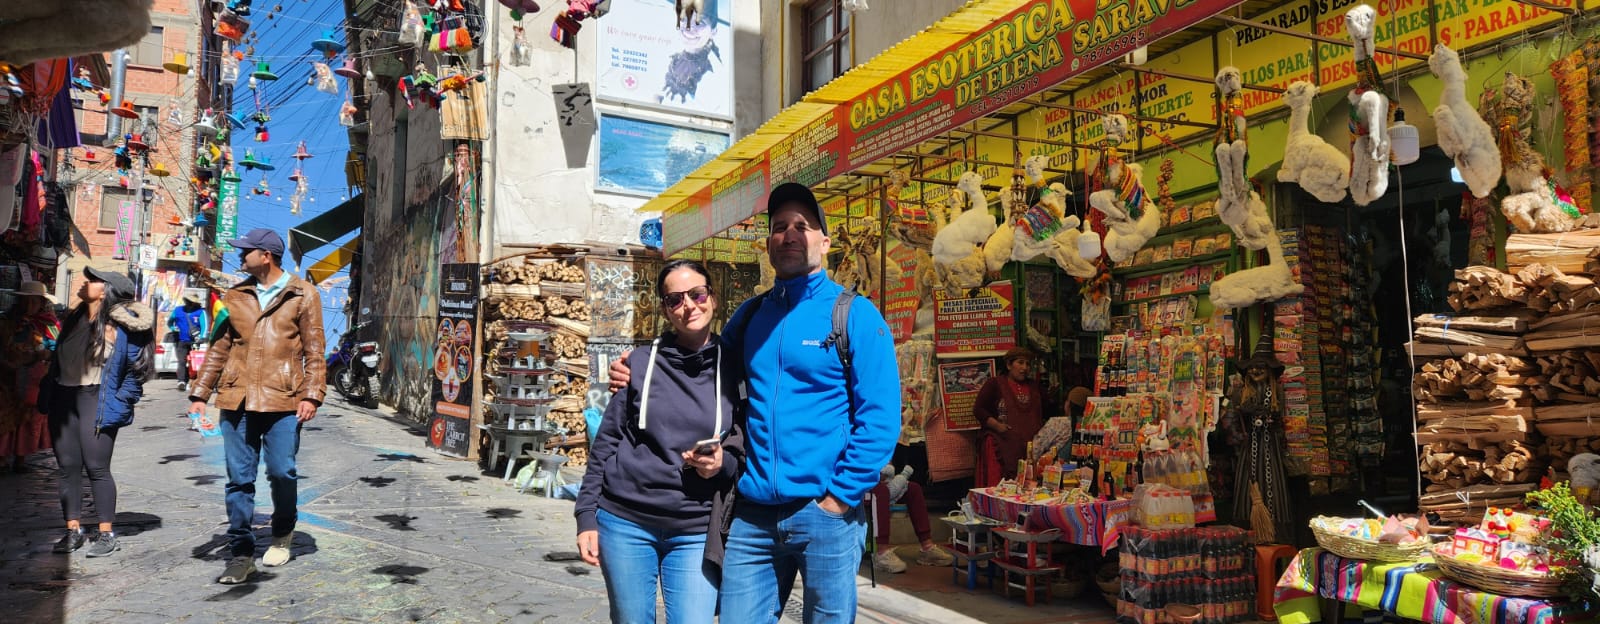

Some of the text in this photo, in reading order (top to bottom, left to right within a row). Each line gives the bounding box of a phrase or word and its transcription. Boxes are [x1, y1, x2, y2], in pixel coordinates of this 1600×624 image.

[849, 87, 906, 131] CASA
[910, 0, 1075, 102] ESOTERICA
[955, 79, 986, 109] DE
[986, 38, 1063, 95] ELENA
[1277, 51, 1313, 76] PARA
[1076, 86, 1123, 111] BLANCA
[1129, 83, 1168, 109] AMOR
